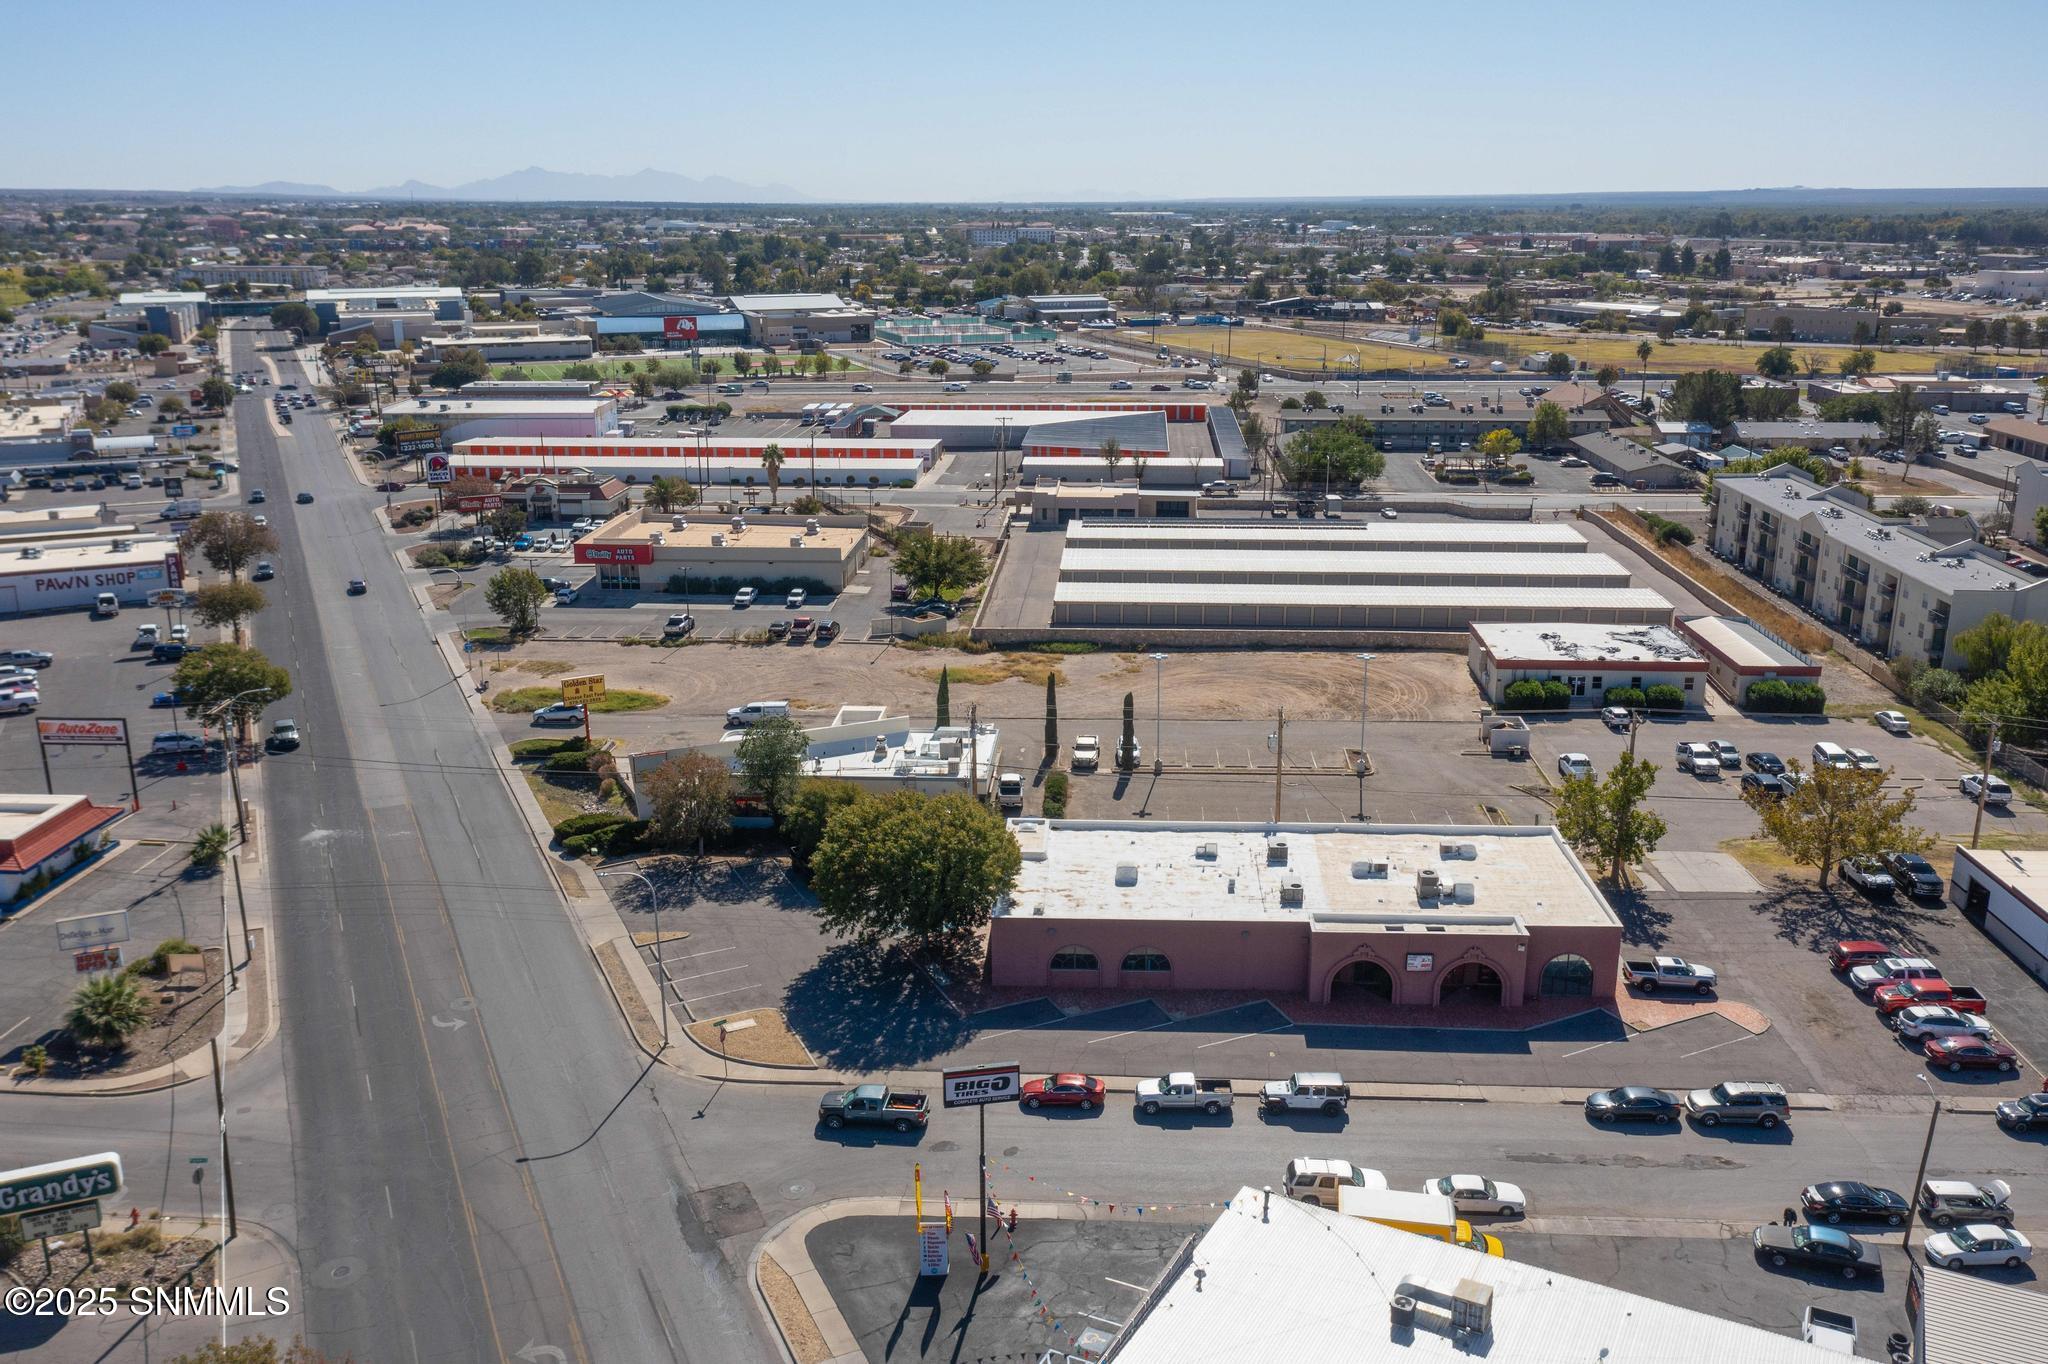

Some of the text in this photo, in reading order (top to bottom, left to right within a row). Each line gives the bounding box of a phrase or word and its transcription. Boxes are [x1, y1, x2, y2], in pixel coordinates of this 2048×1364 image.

[35, 574, 89, 591] PAWN
[95, 571, 136, 587] SHOP
[563, 676, 603, 689] Golden Star
[56, 722, 118, 735] AutoZone
[954, 1079, 991, 1092] BIG
[954, 1089, 989, 1098] TIRES
[0, 1169, 112, 1210] Grandy's
